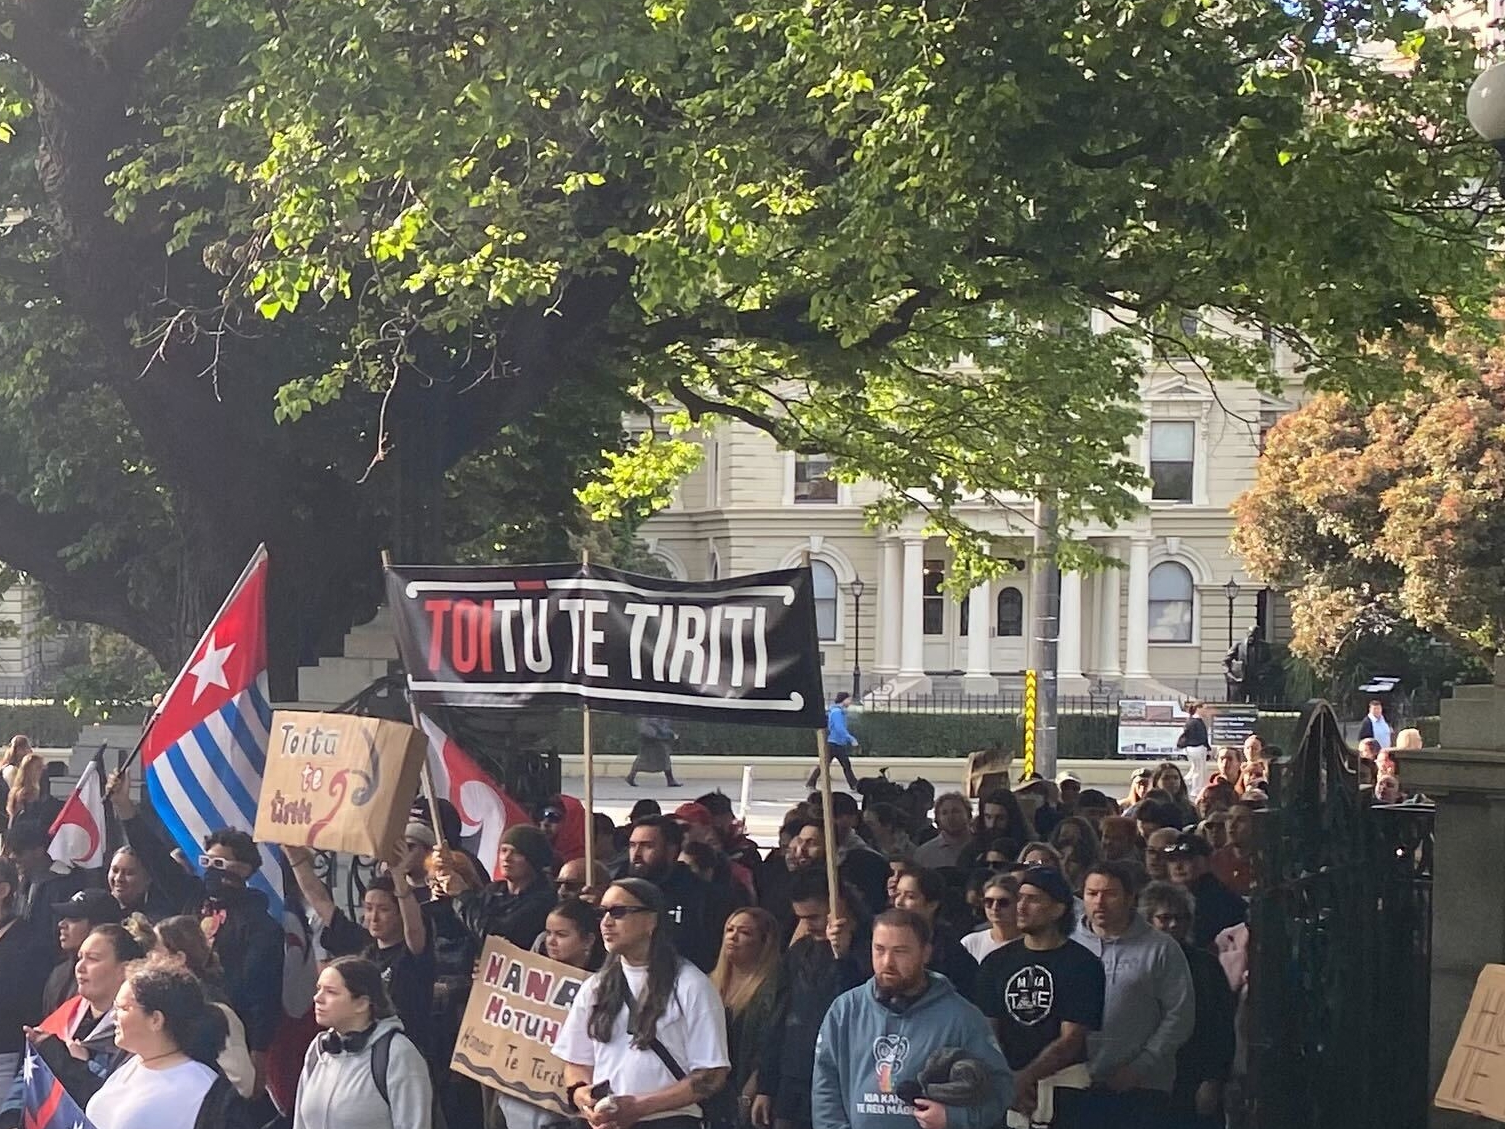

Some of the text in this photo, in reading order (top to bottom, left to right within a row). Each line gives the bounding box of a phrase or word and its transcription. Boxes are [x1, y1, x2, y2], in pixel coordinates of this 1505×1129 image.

[559, 599, 609, 678] TE
[623, 603, 768, 689] TIRITI
[281, 723, 338, 756] Toitū
[301, 762, 323, 791] te
[482, 993, 562, 1046] MOTUH
[505, 1044, 518, 1070] Te
[532, 1057, 566, 1088] Tirit
